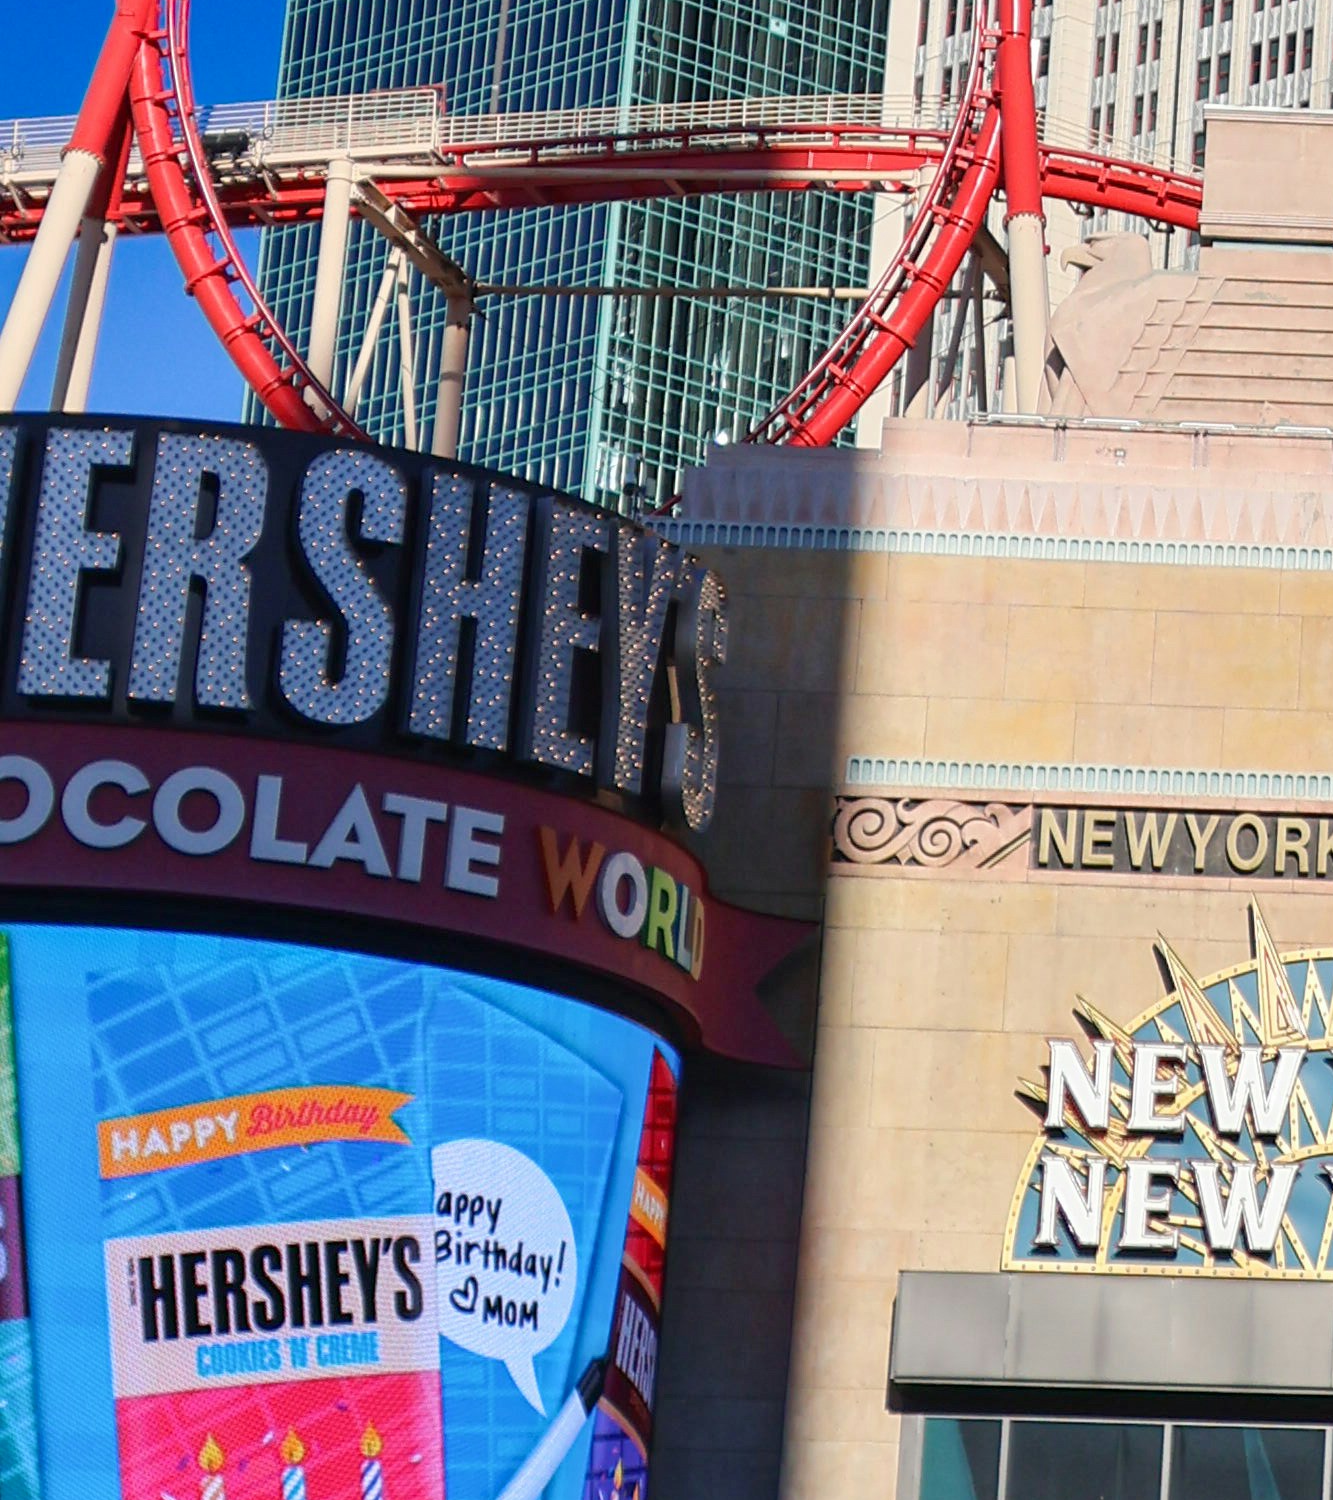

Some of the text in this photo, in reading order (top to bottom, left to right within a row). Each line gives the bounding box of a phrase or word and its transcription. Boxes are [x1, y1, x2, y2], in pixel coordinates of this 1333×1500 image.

[0, 426, 728, 832] ERSHEY'S
[540, 825, 706, 980] WORLD
[110, 1099, 379, 1160] HAPPY Birthday
[1044, 1039, 1302, 1138] NEW
[1034, 1153, 1298, 1250] NEW
[138, 1235, 423, 1343] HERSHEY'S
[435, 1229, 566, 1294] Birthday!
[195, 1338, 283, 1378] COOKIES
[316, 1331, 380, 1367] CREME
[482, 1294, 539, 1331] MOM
